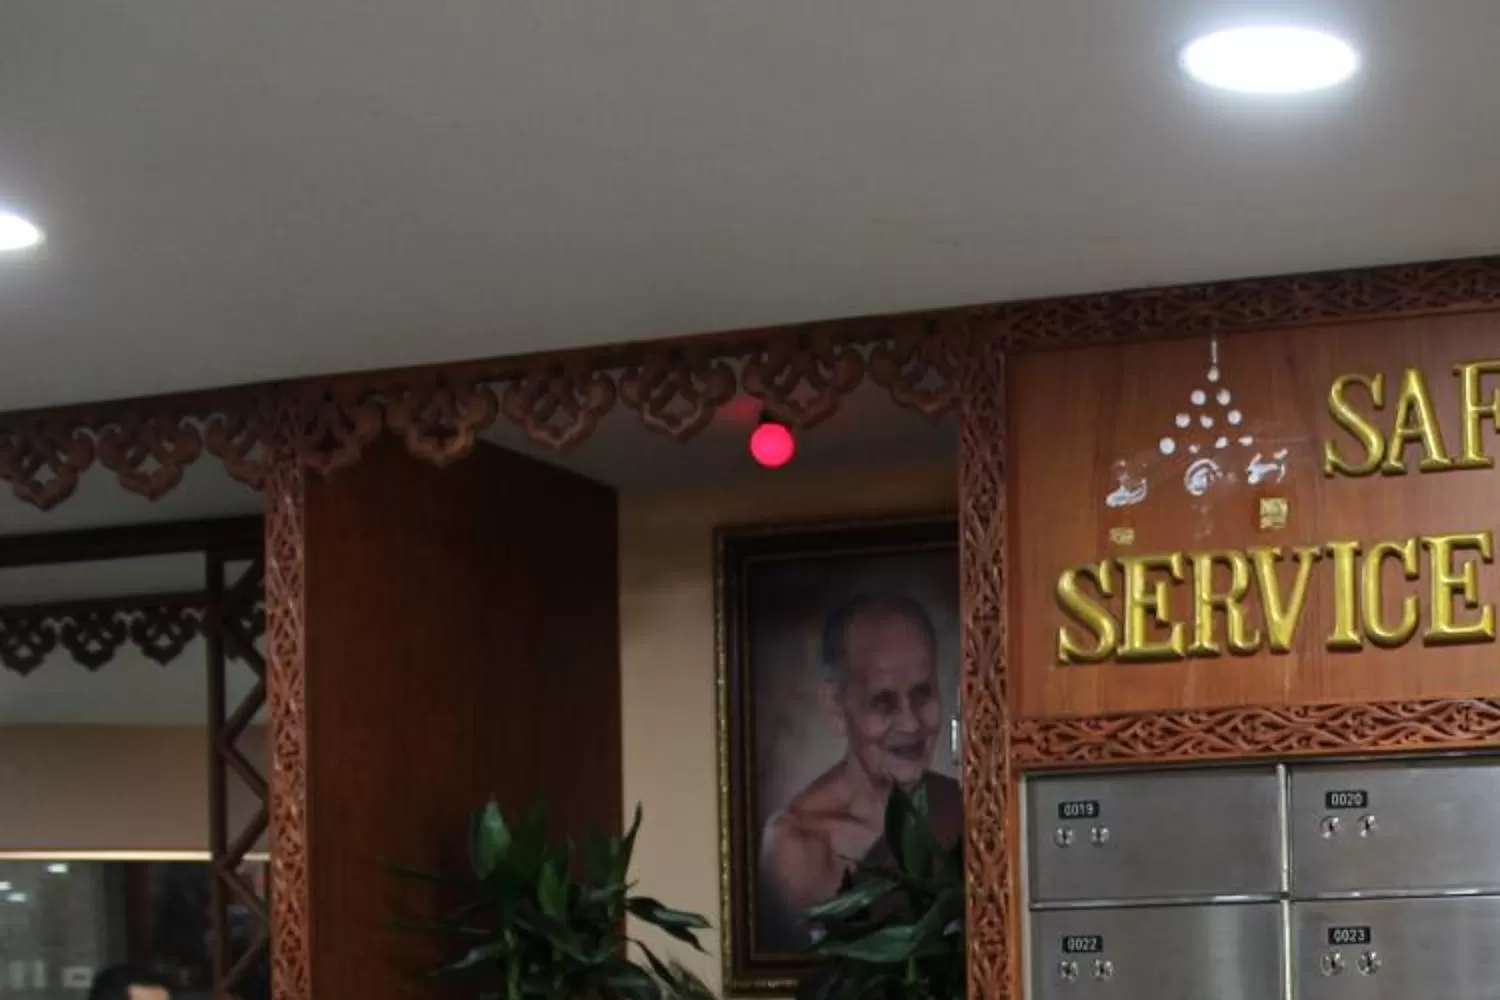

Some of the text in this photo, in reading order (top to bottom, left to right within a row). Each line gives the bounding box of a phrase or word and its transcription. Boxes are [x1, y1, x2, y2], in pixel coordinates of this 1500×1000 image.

[1055, 530, 1496, 664] SERVICE
[1330, 792, 1364, 806] 0020
[1332, 928, 1366, 943] 0023
[1066, 937, 1098, 951] 0022
